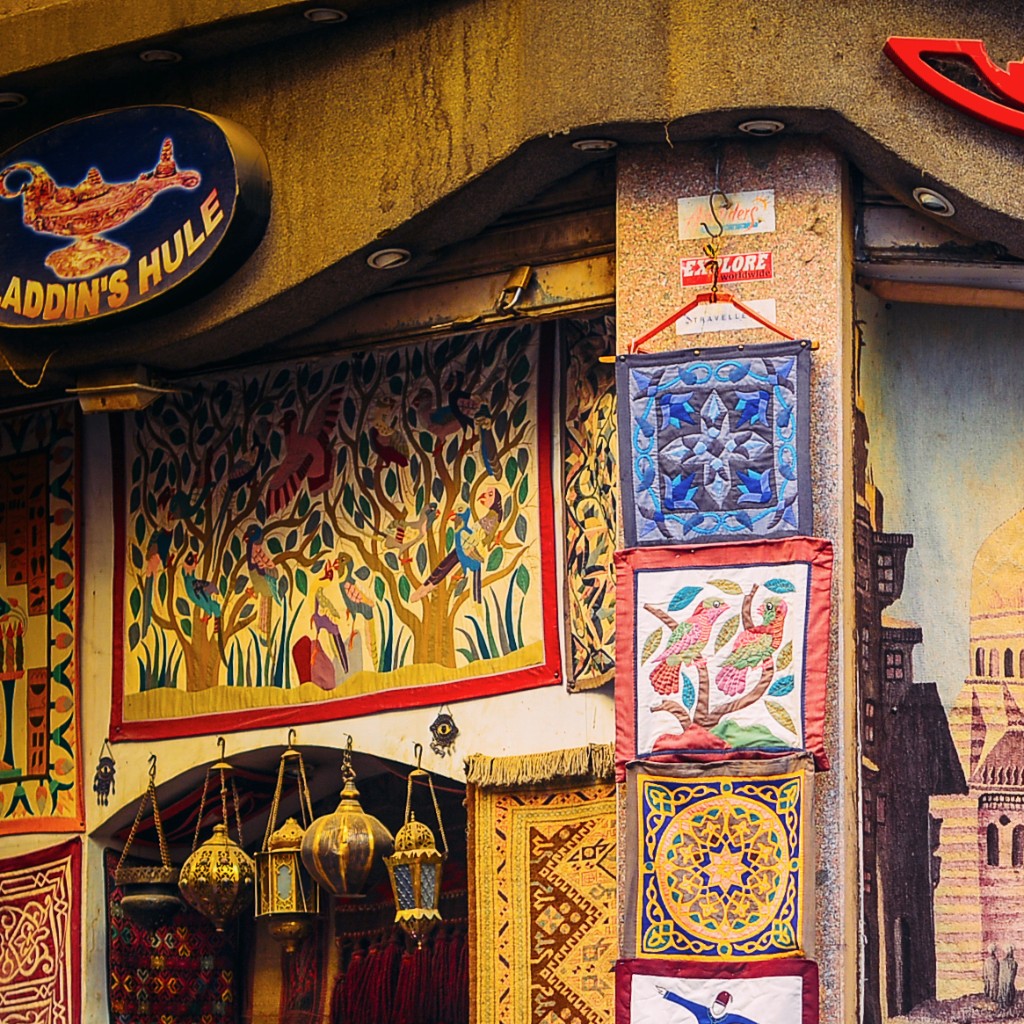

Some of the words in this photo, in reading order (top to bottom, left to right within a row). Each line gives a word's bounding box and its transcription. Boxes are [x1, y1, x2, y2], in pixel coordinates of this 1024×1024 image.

[0, 269, 129, 320] ADDIN'S
[138, 187, 224, 295] HULE
[720, 270, 771, 281] worldwide
